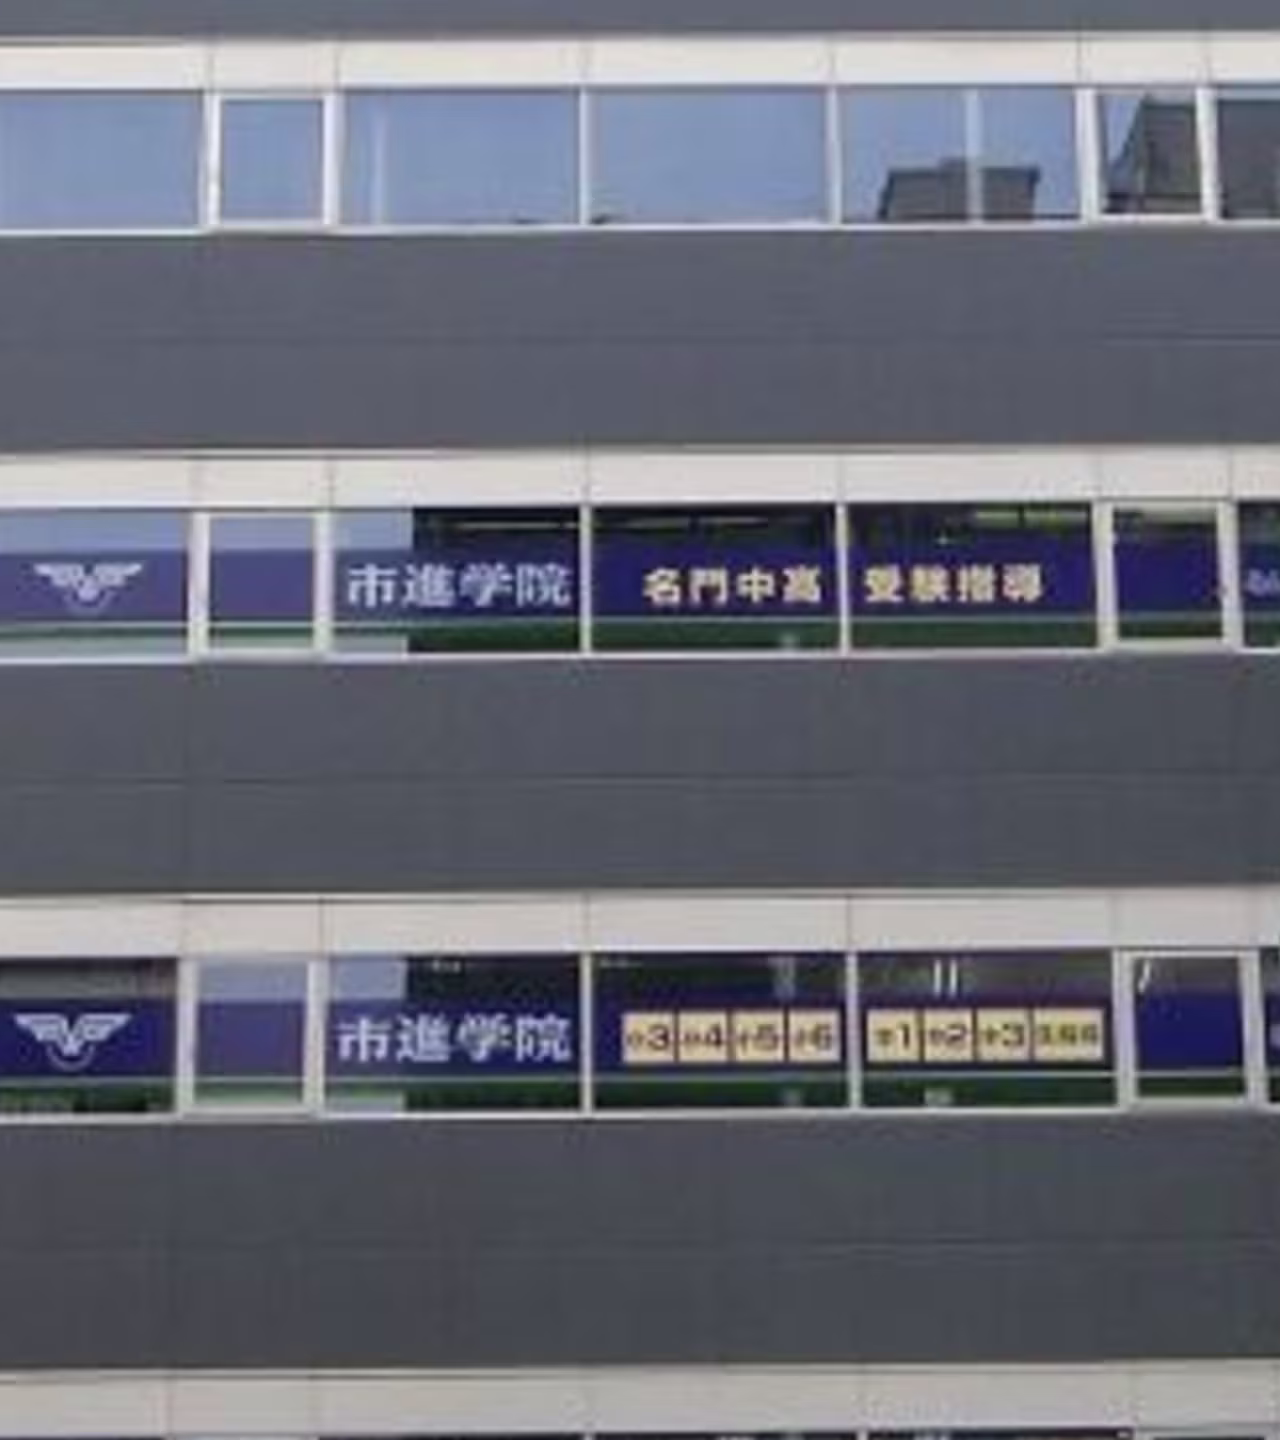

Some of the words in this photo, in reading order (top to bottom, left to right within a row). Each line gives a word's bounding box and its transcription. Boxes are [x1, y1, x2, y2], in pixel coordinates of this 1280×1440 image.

[348, 563, 573, 608] 市進学院
[642, 565, 821, 605] 名門中高
[864, 564, 1043, 603] 受験指導
[336, 1013, 573, 1062] 市進学院
